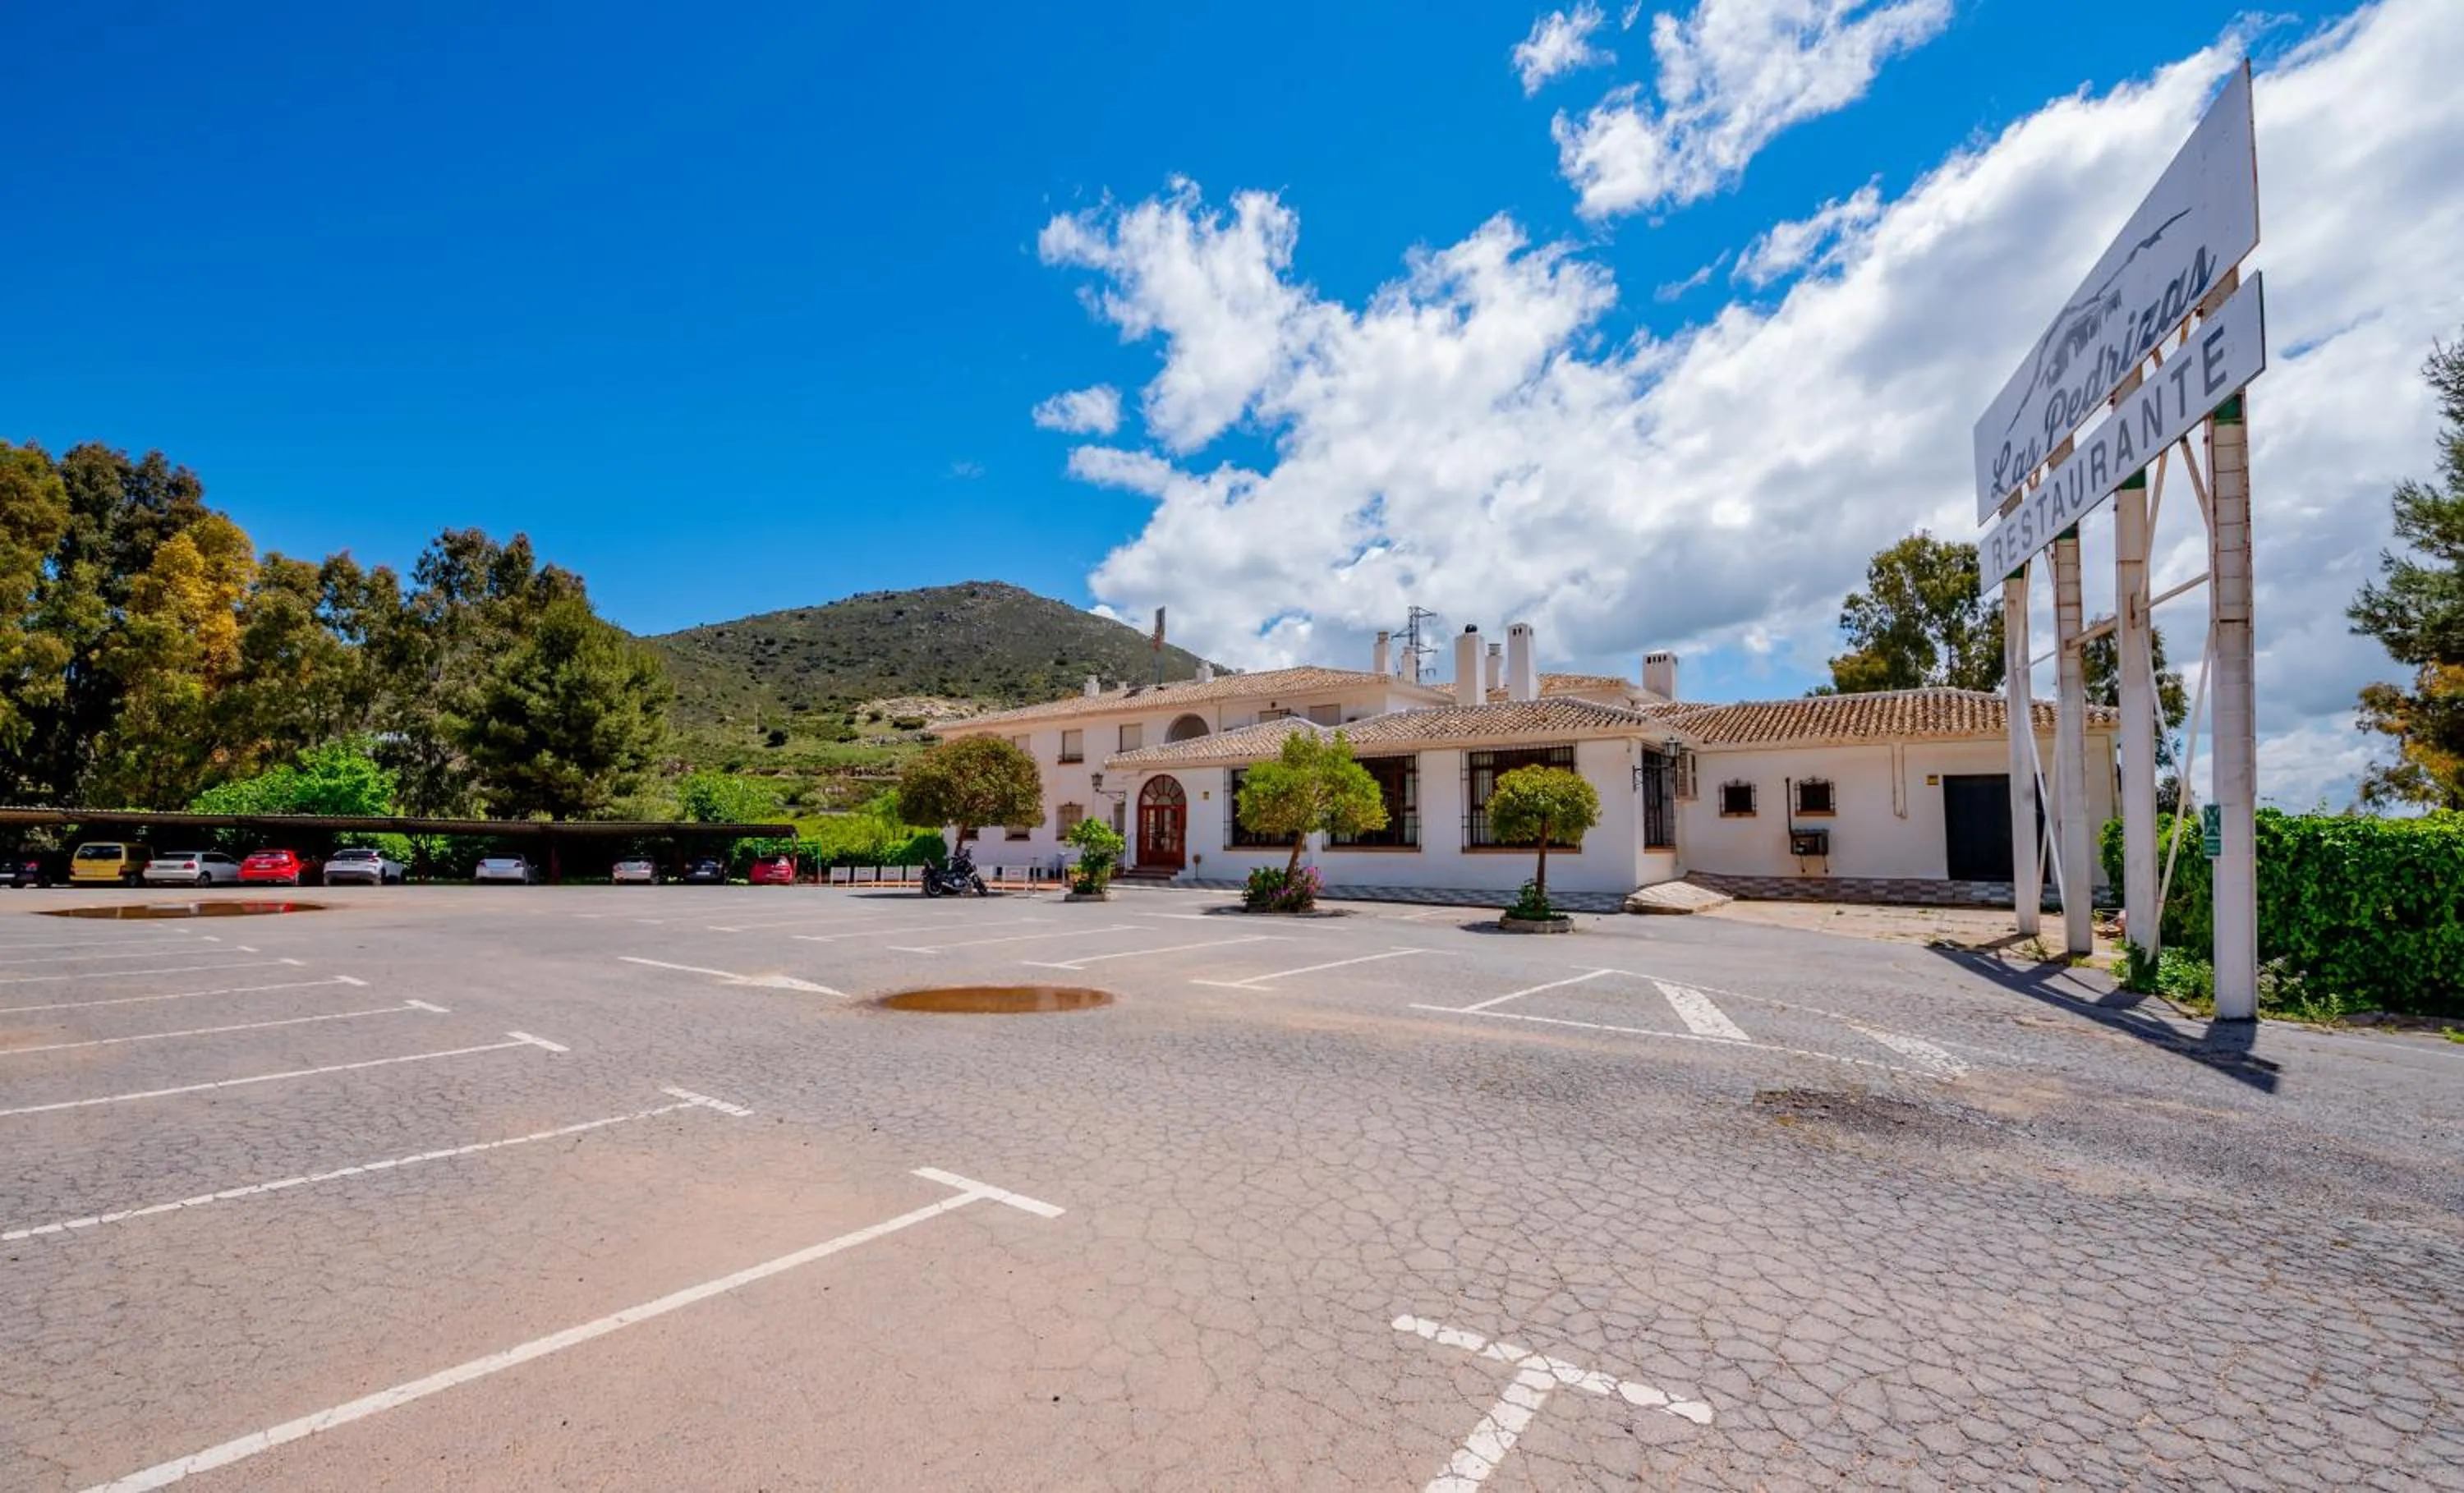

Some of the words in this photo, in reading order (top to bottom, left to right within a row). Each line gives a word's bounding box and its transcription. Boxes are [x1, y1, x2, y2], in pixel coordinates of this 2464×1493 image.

[1991, 439, 2041, 498] Las
[2044, 244, 2217, 452] Pedrizas
[1992, 326, 2227, 575] RESTAURANTE
